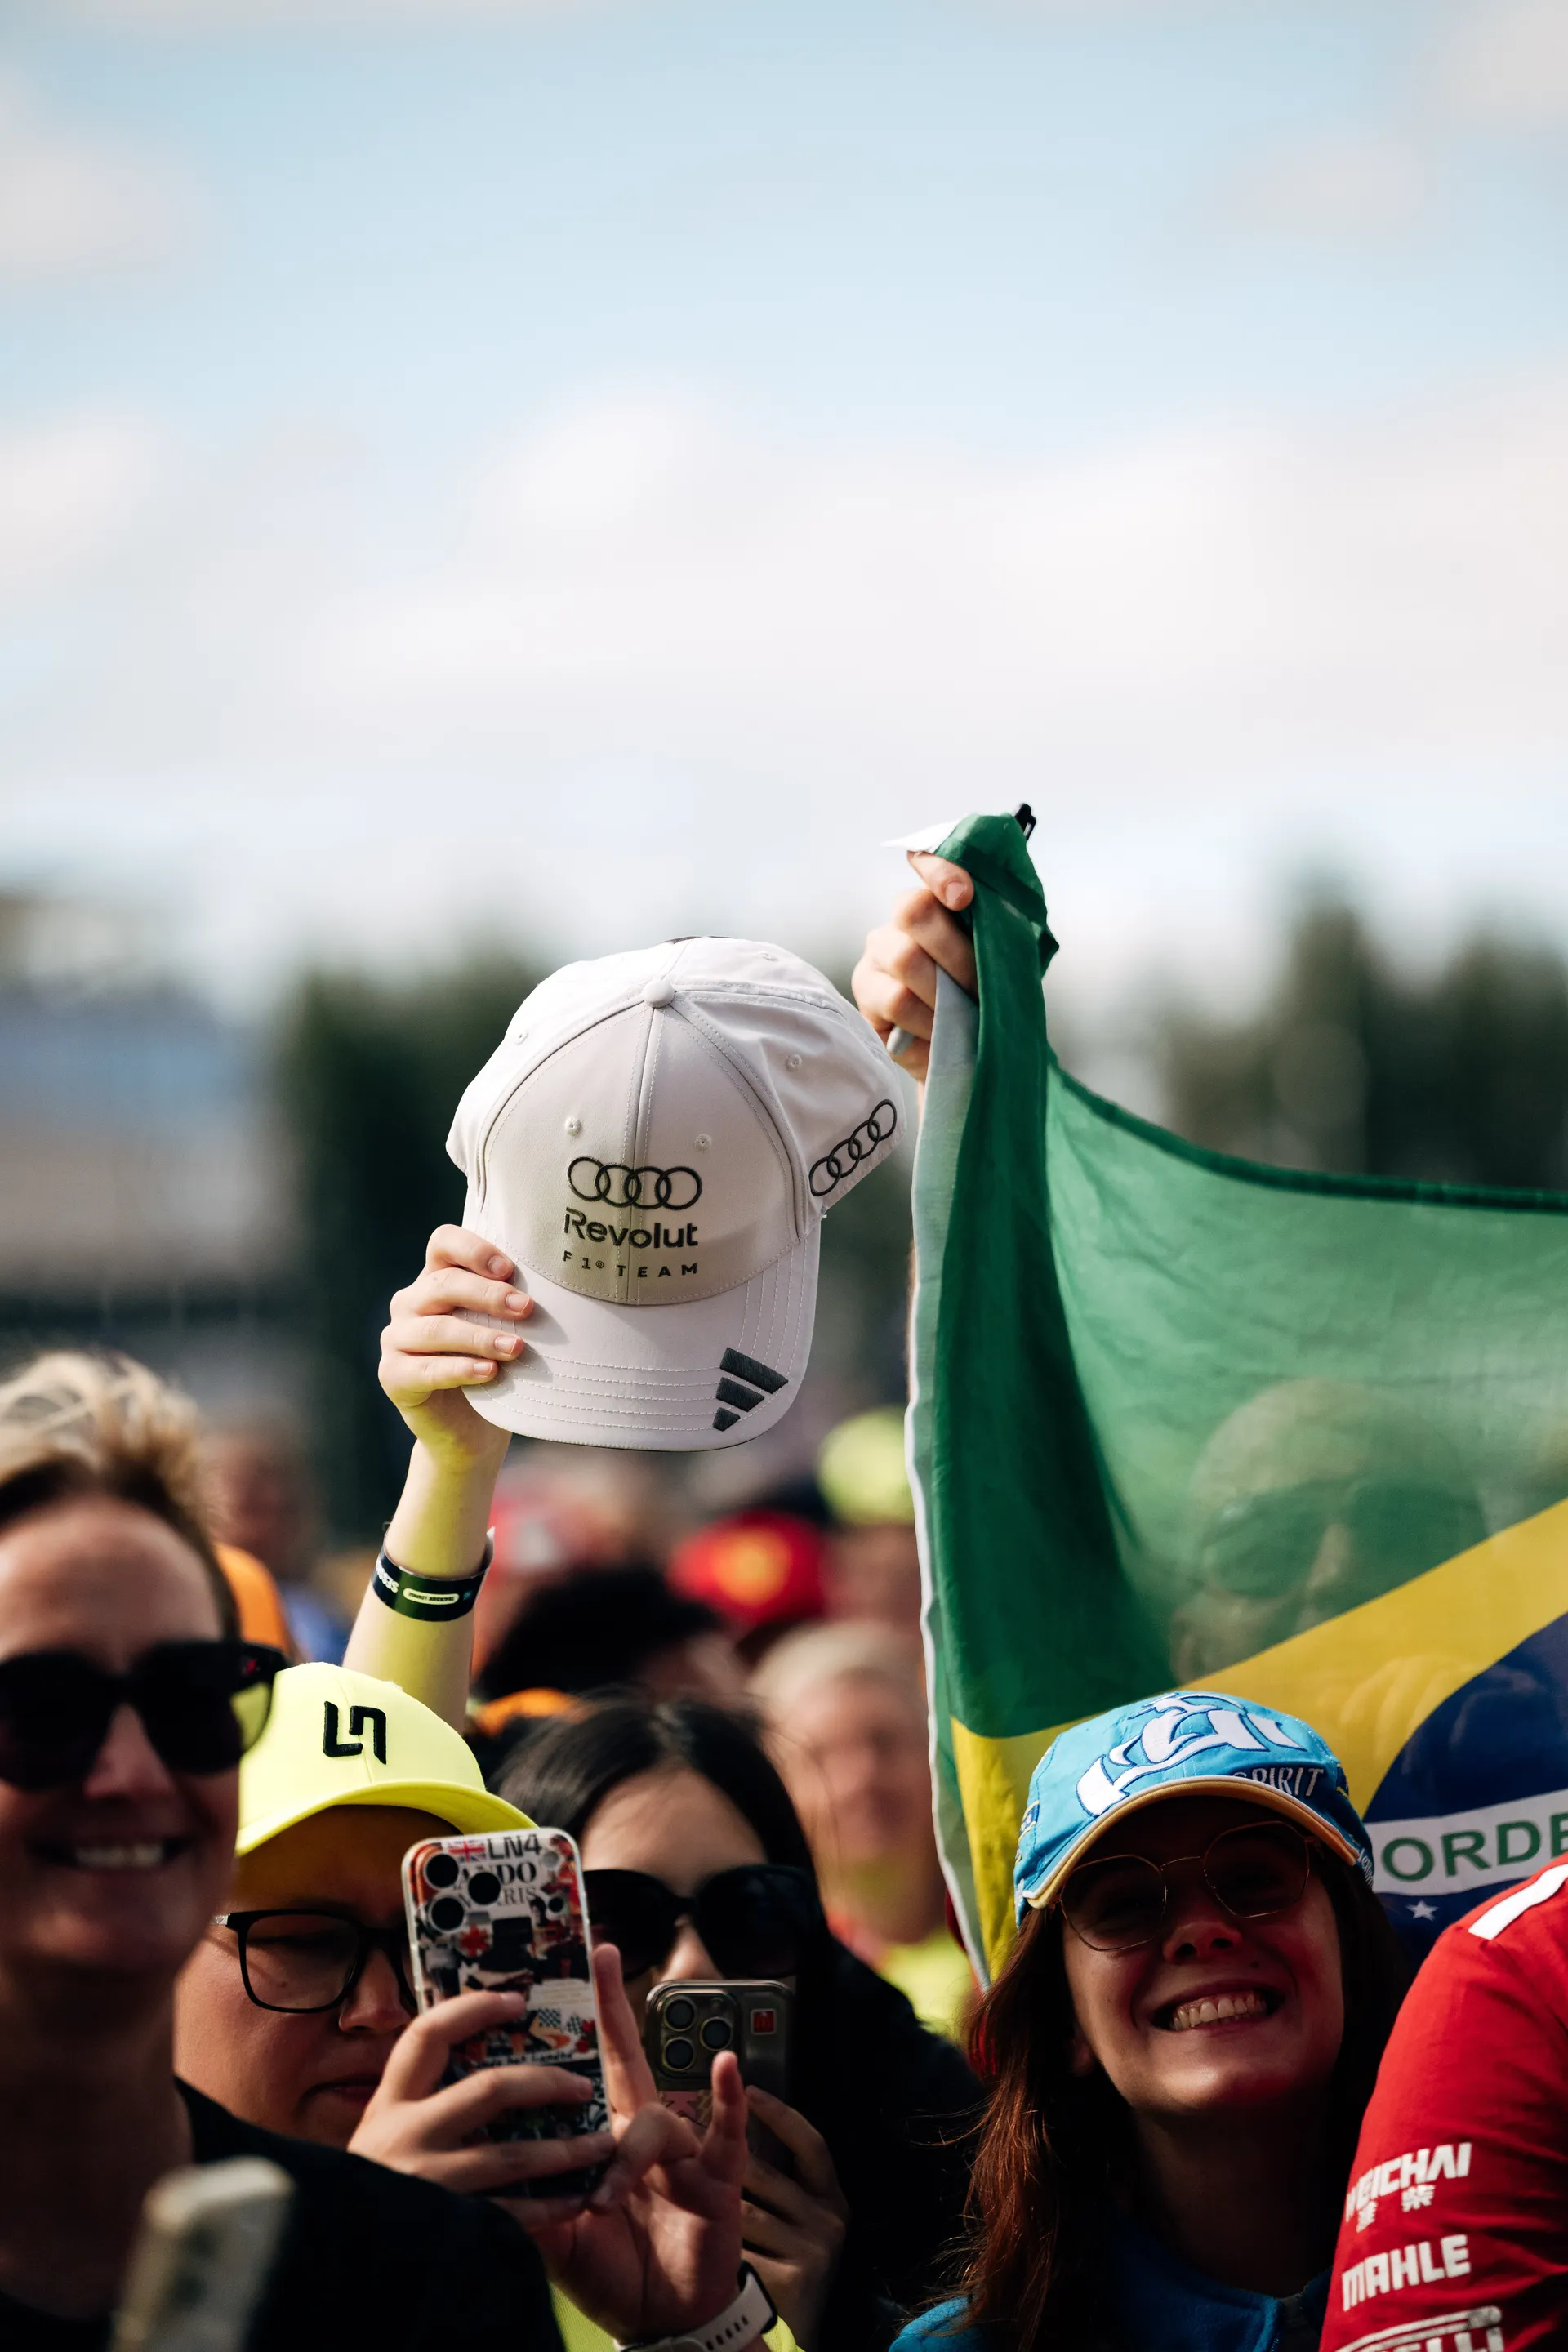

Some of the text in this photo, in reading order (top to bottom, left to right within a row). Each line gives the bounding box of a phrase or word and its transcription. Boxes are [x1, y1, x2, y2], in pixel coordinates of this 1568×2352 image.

[564, 1206, 699, 1249] Revolut
[616, 1262, 698, 1278] TEAM
[487, 1833, 542, 1860] LN4
[1342, 2234, 1472, 2313] MAHLE
